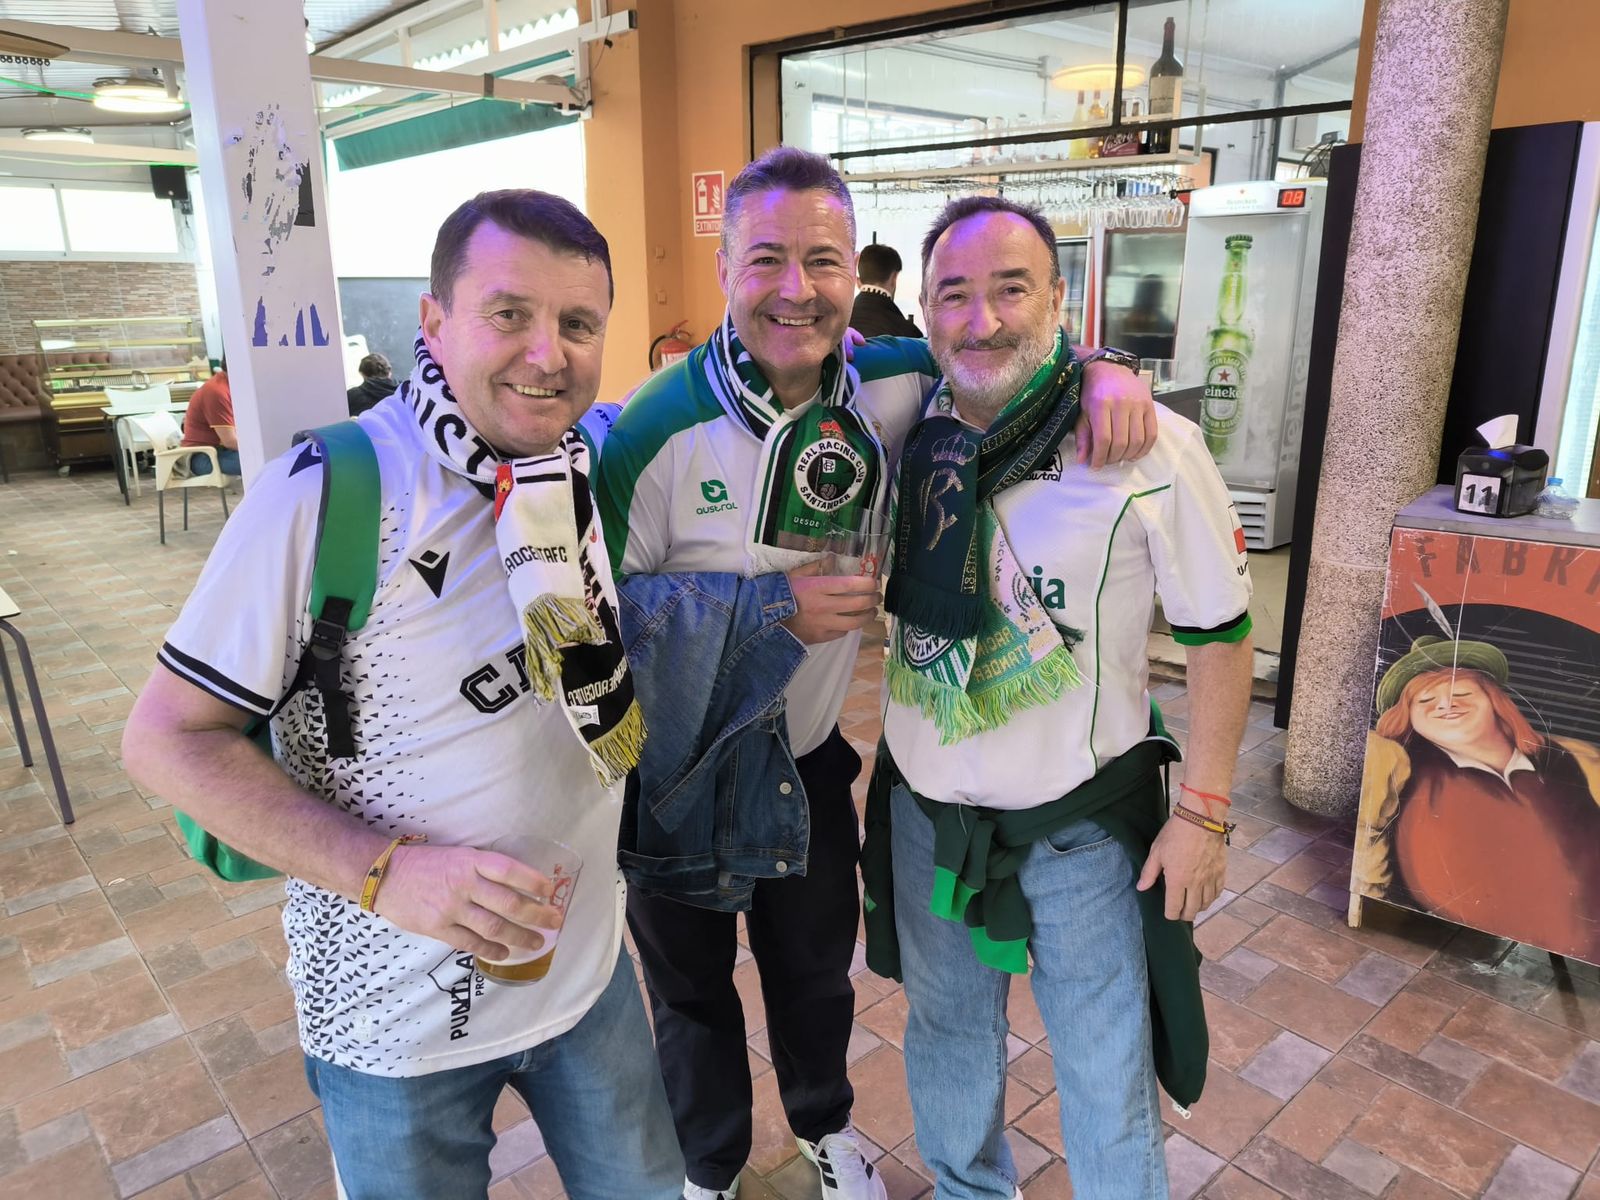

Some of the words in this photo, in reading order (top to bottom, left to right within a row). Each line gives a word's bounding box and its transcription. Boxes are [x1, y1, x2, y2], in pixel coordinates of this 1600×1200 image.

[696, 220, 721, 233] EXTINTO
[797, 448, 818, 472] REAL
[819, 441, 857, 461] RACING
[800, 485, 851, 510] SANTANDER
[793, 516, 820, 528] DESDE
[475, 972, 486, 997] PRO
